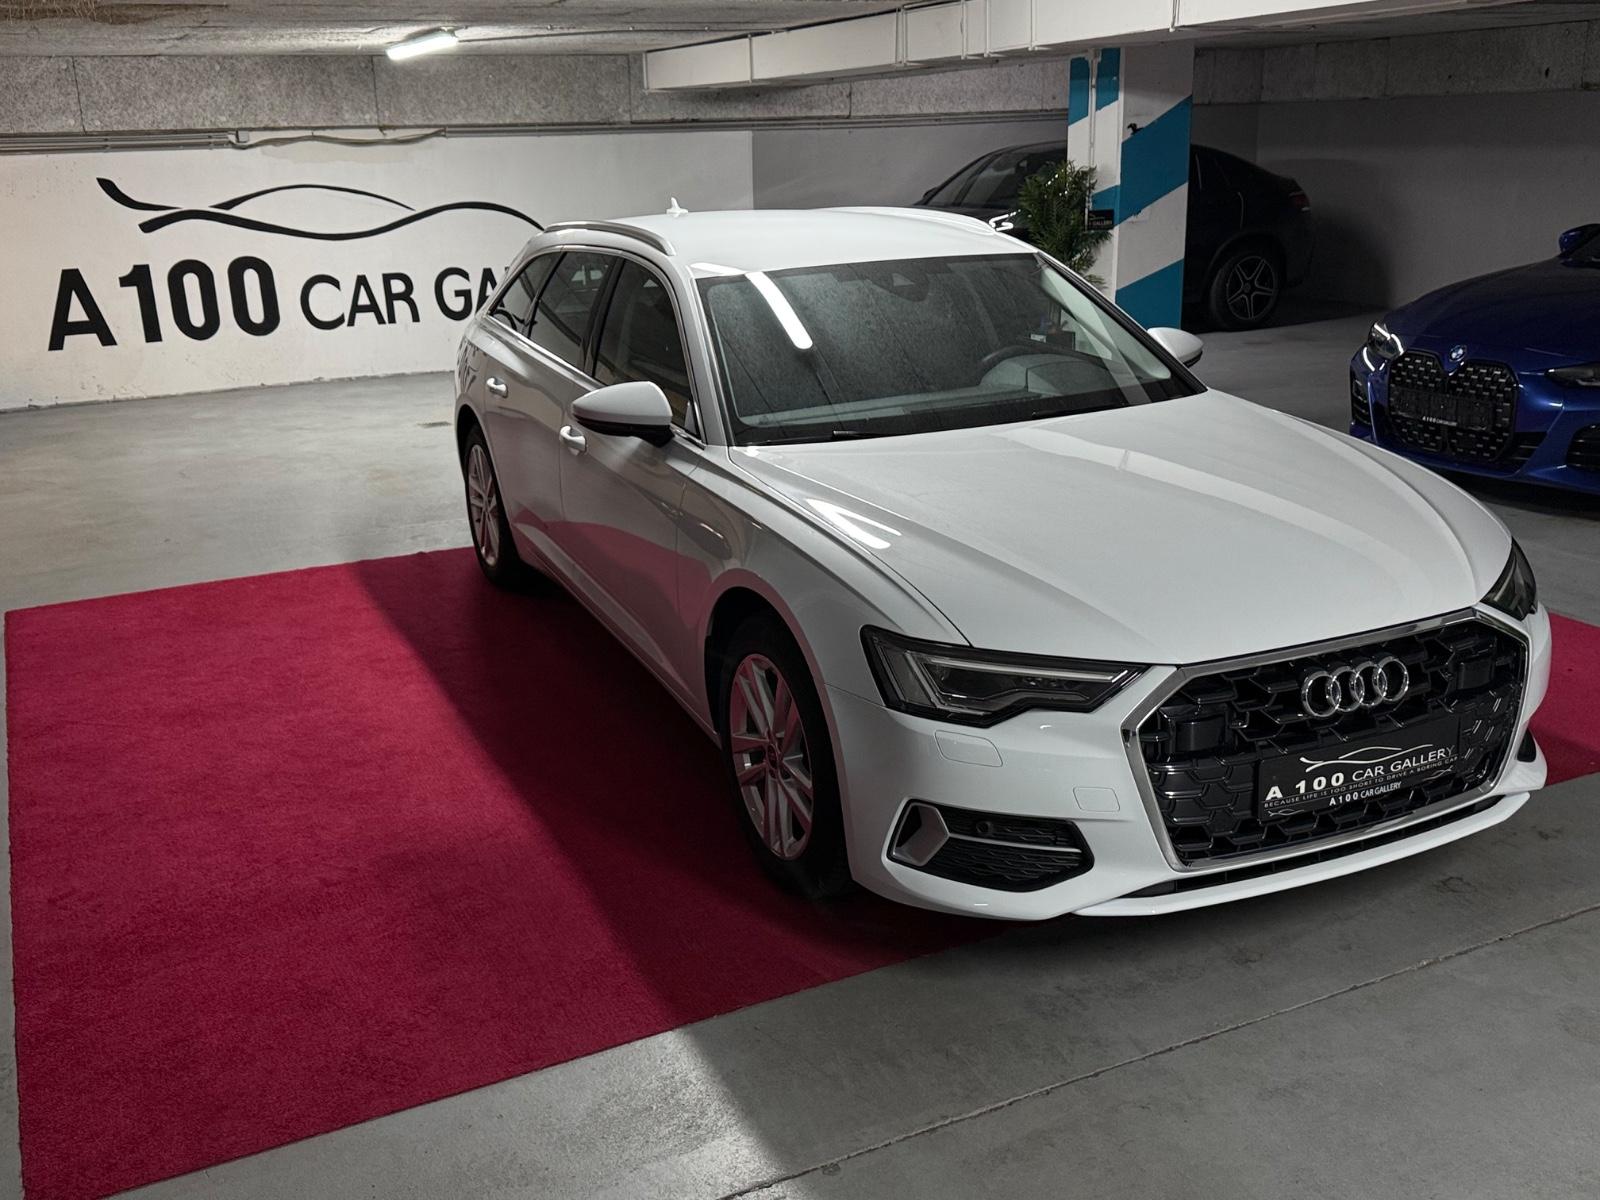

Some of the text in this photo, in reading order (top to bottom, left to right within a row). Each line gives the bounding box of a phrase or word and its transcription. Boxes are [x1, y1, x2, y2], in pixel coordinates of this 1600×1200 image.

[300, 272, 420, 330] CAR
[434, 266, 509, 321] GA
[1352, 765, 1385, 781] CAR
[1390, 745, 1454, 771] GALLERY
[1264, 797, 1300, 808] BECAUSE
[1303, 793, 1318, 801] LIFE
[1330, 786, 1347, 794] TOO
[1349, 780, 1372, 790] SHORT
[1386, 770, 1407, 780] DRIVE
[1417, 761, 1443, 772] BORING
[1360, 788, 1374, 799] CAR
[1374, 781, 1402, 796] GALLERY
